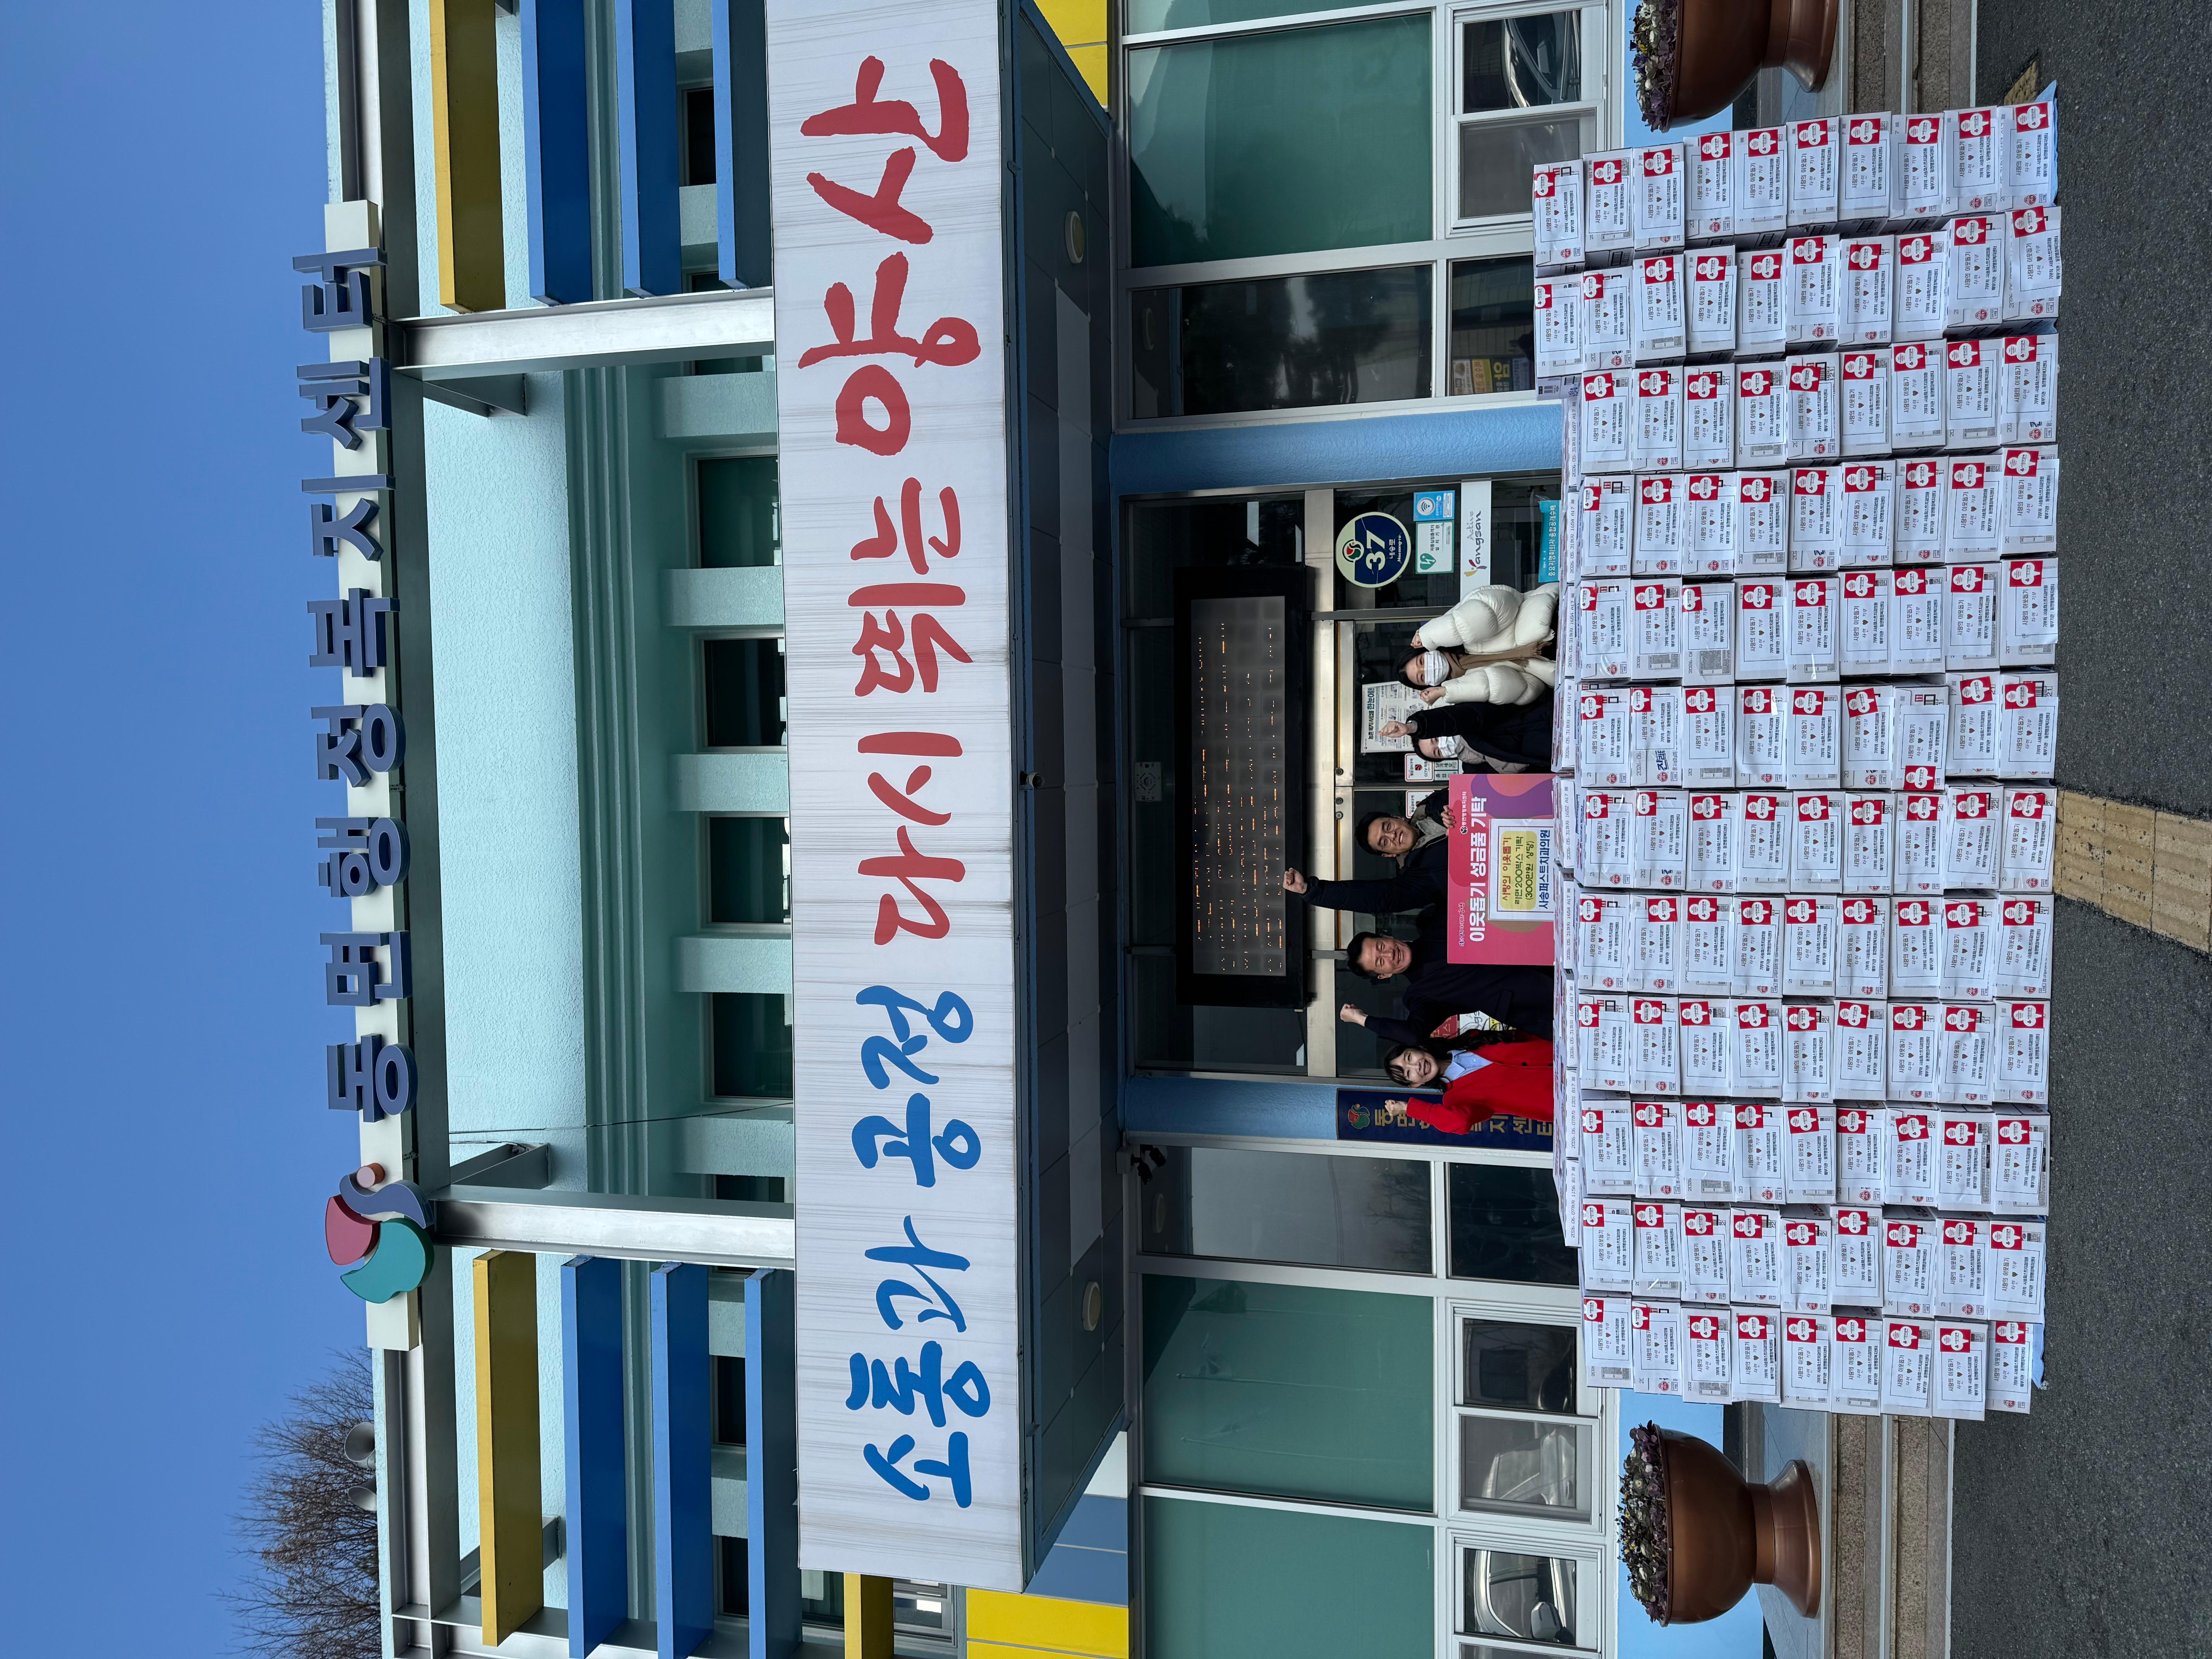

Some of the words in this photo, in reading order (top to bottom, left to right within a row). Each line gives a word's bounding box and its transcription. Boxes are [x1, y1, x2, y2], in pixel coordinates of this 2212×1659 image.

[797, 55, 982, 457] 양산
[1466, 511, 1474, 541] Active
[1365, 530, 1386, 570] 37
[847, 477, 973, 697] 뛰는
[292, 247, 417, 1122] 동면행정복지센터
[1655, 750, 1669, 771] 진라
[1471, 797, 1487, 827] 기탁
[857, 731, 965, 945] 다시
[1470, 832, 1486, 878] 성금품
[1503, 838, 1511, 871] 이웃돕기
[1515, 836, 1523, 852] 기탁
[1525, 841, 1535, 859] 상당)
[1503, 876, 1511, 901] 사랑의
[1525, 864, 1534, 900] (300만원
[1538, 830, 1550, 909] 사송퍼스트치과의원
[1469, 883, 1486, 942] 이웃돕기
[850, 985, 982, 1187] 공정
[845, 1215, 991, 1508] 소통과
